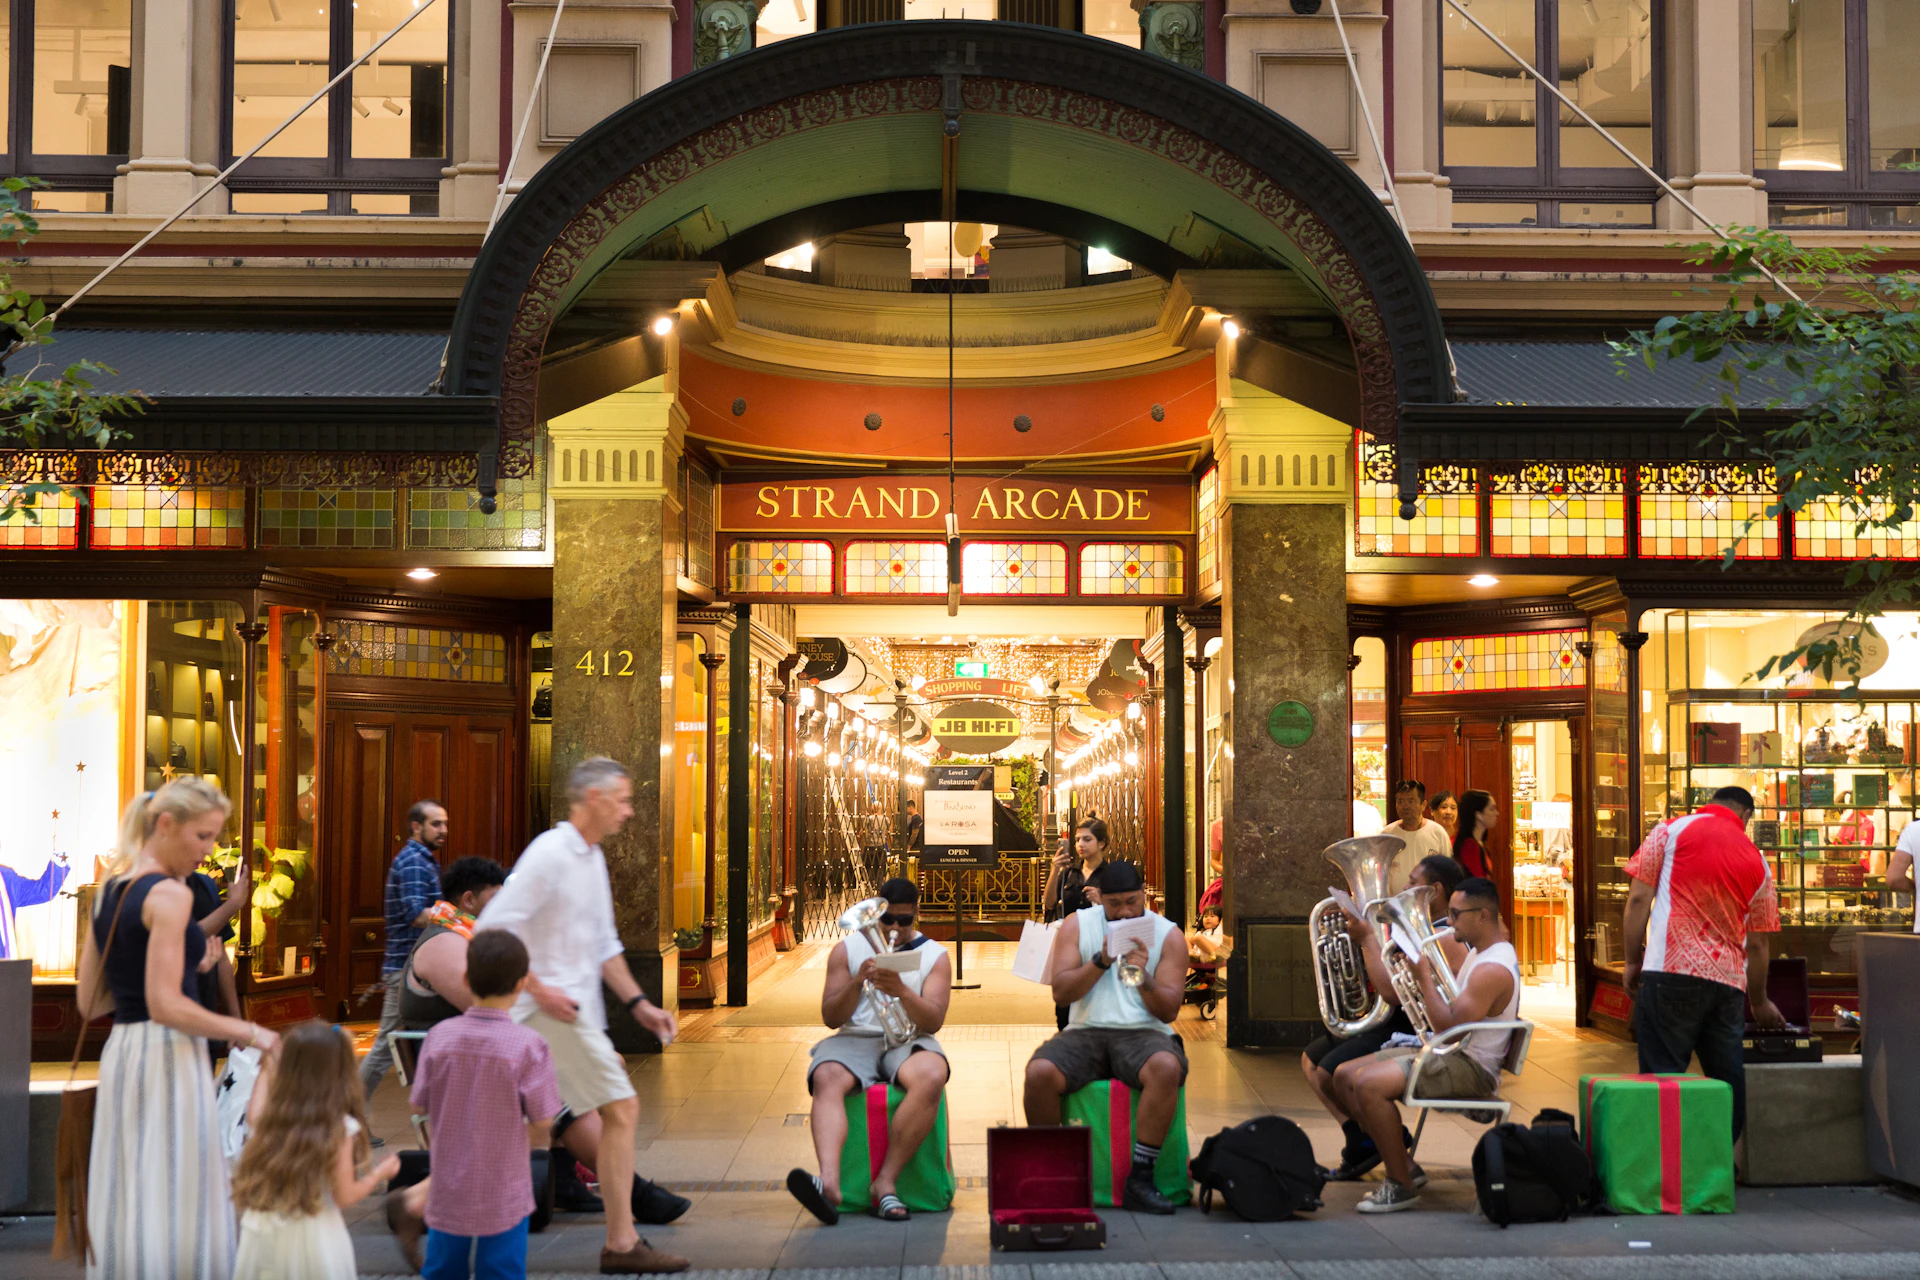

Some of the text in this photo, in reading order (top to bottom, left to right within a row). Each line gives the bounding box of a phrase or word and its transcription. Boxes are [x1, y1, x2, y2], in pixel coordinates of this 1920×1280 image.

[755, 485, 1151, 521] STRAND ARCADE
[797, 643, 824, 653] DNEY
[575, 649, 635, 676] 412
[924, 681, 1030, 697] SHOPPING LIFT
[940, 720, 966, 733] JB
